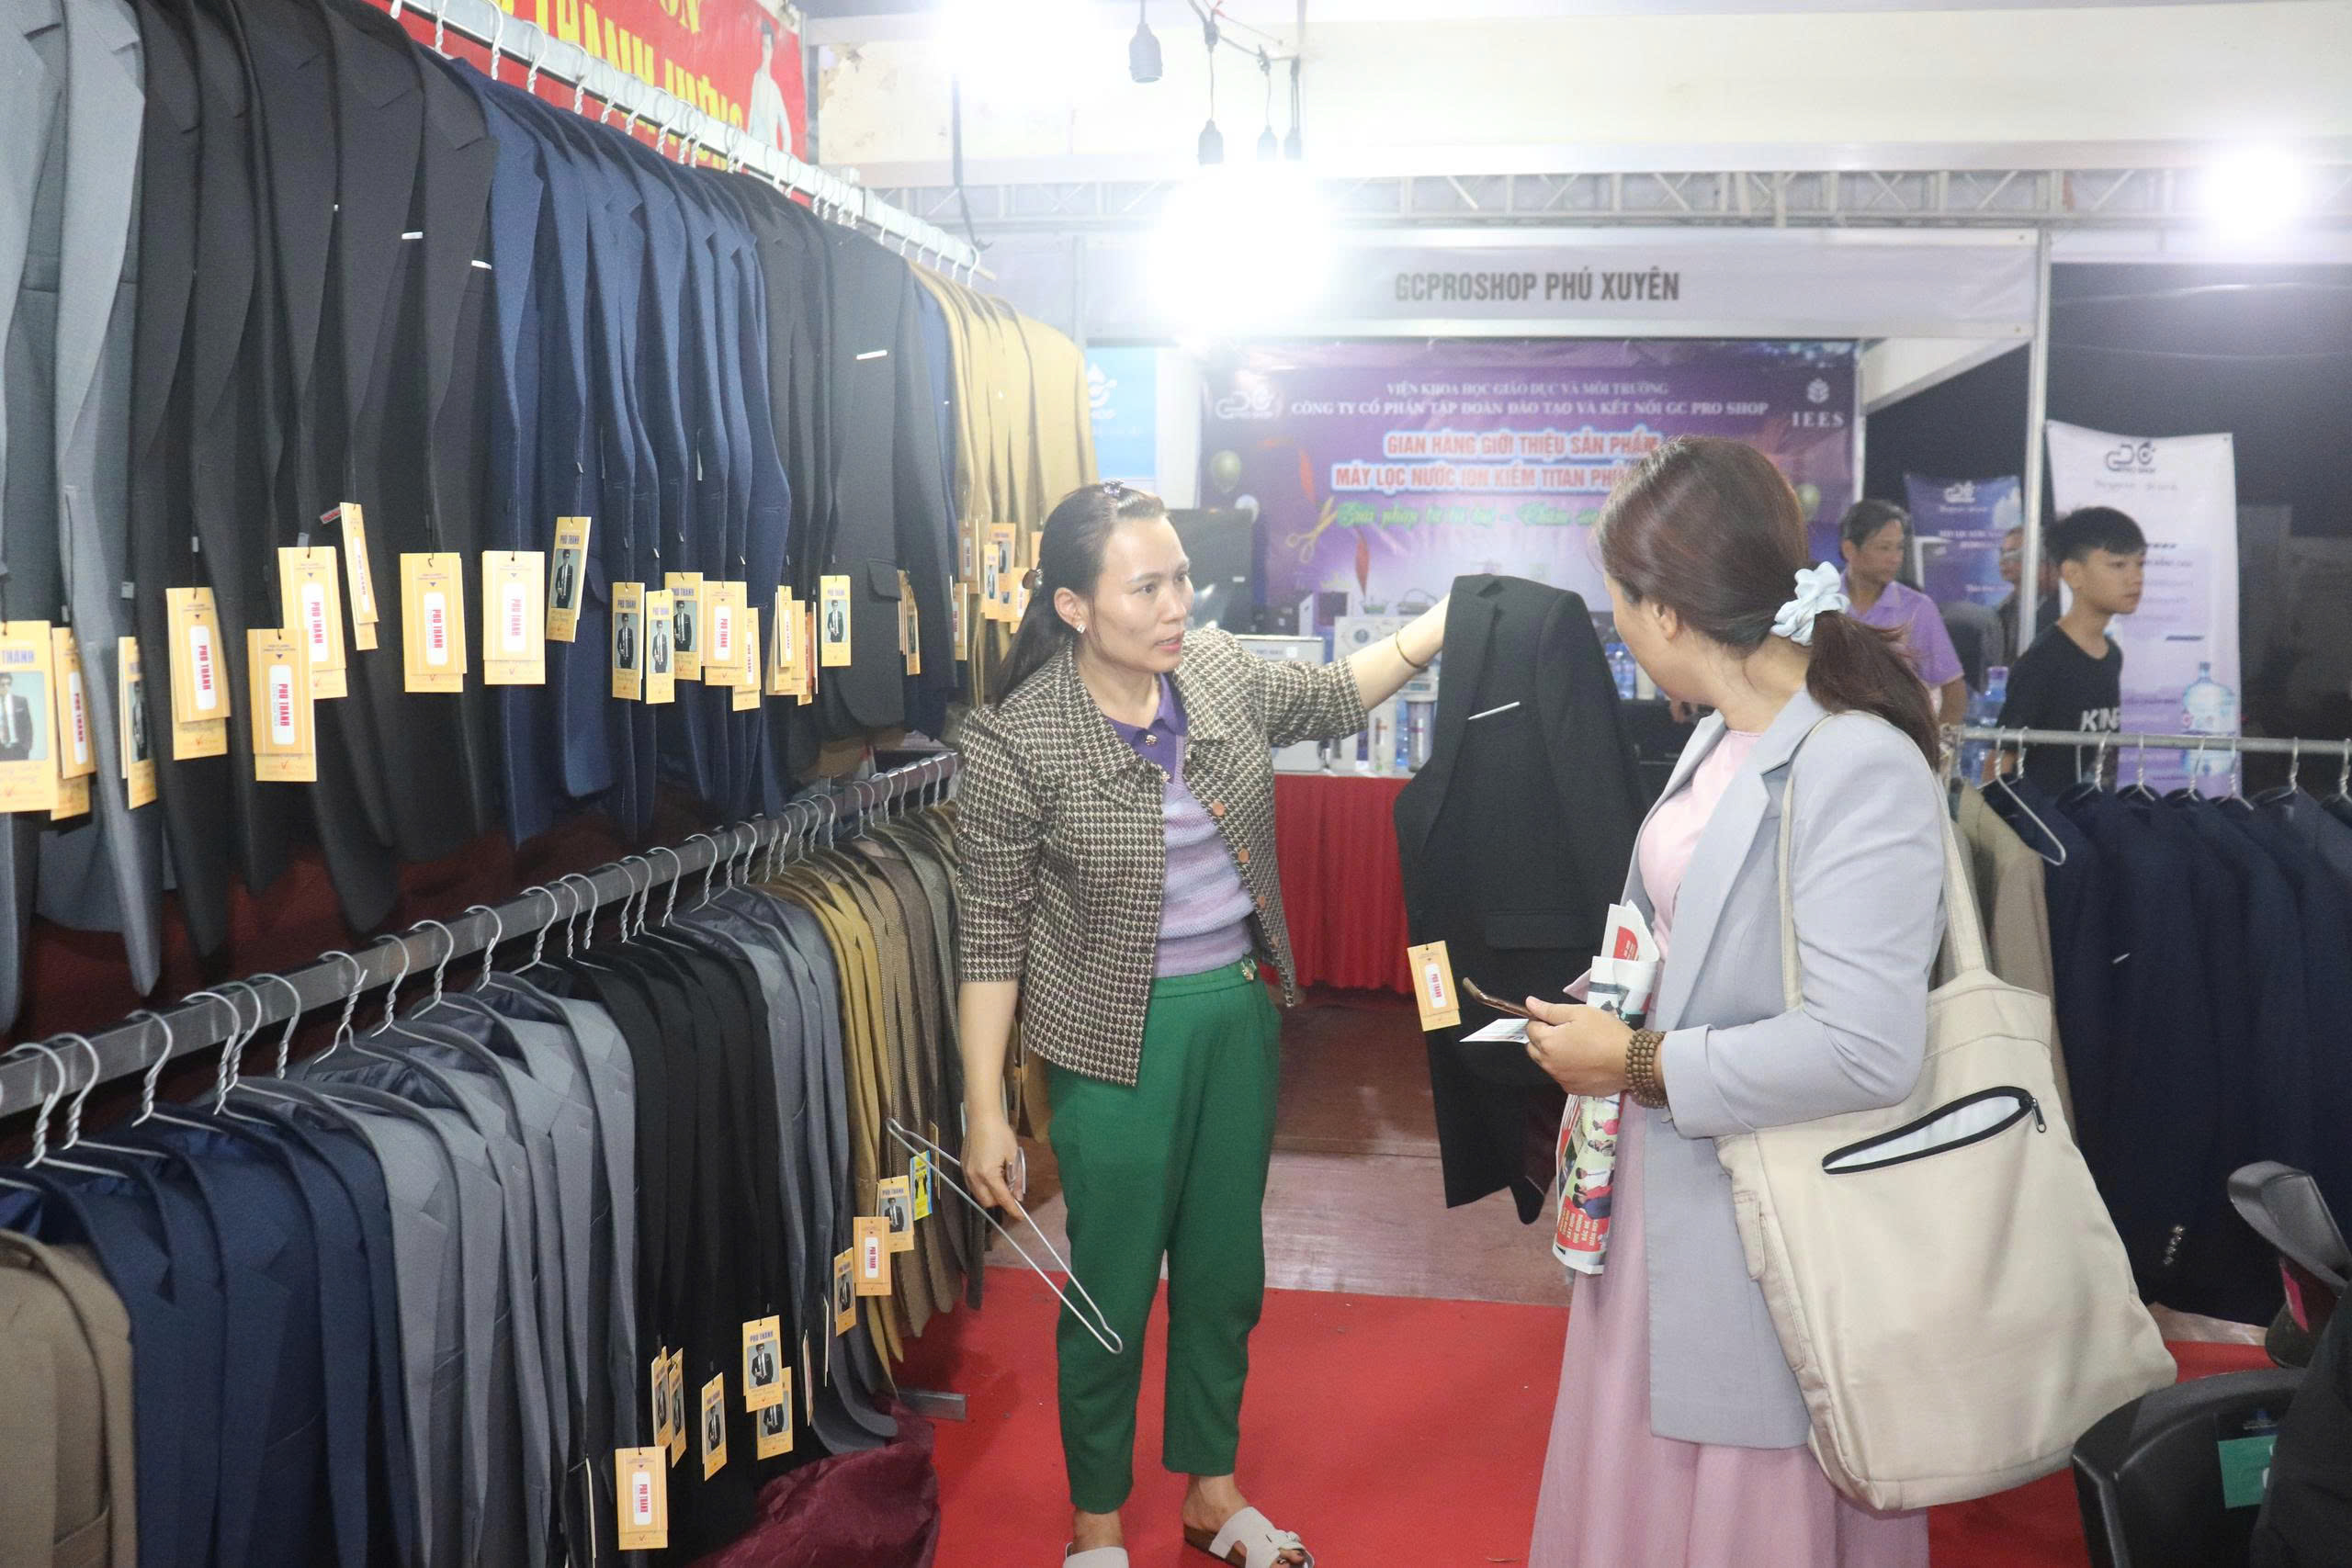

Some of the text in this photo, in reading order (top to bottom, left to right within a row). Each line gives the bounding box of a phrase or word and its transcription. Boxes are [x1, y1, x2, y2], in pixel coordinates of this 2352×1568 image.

[1395, 265, 1680, 301] GCPROSHOP PHÚ XUYÊN
[1291, 400, 1334, 415] CÔNG
[1336, 401, 1355, 415] TY
[1690, 400, 1723, 415] PRO
[1724, 400, 1770, 415] SHOP
[1792, 411, 1845, 428] IEES
[1386, 435, 1426, 455] GIAN
[1430, 429, 1476, 455] HÀNG
[1335, 462, 1372, 487] MÁY
[1375, 468, 1407, 493] LỌC
[433, 626, 443, 649] THANH
[200, 664, 211, 691] THANH
[279, 703, 290, 727] THANH
[2080, 706, 2120, 732] KIN
